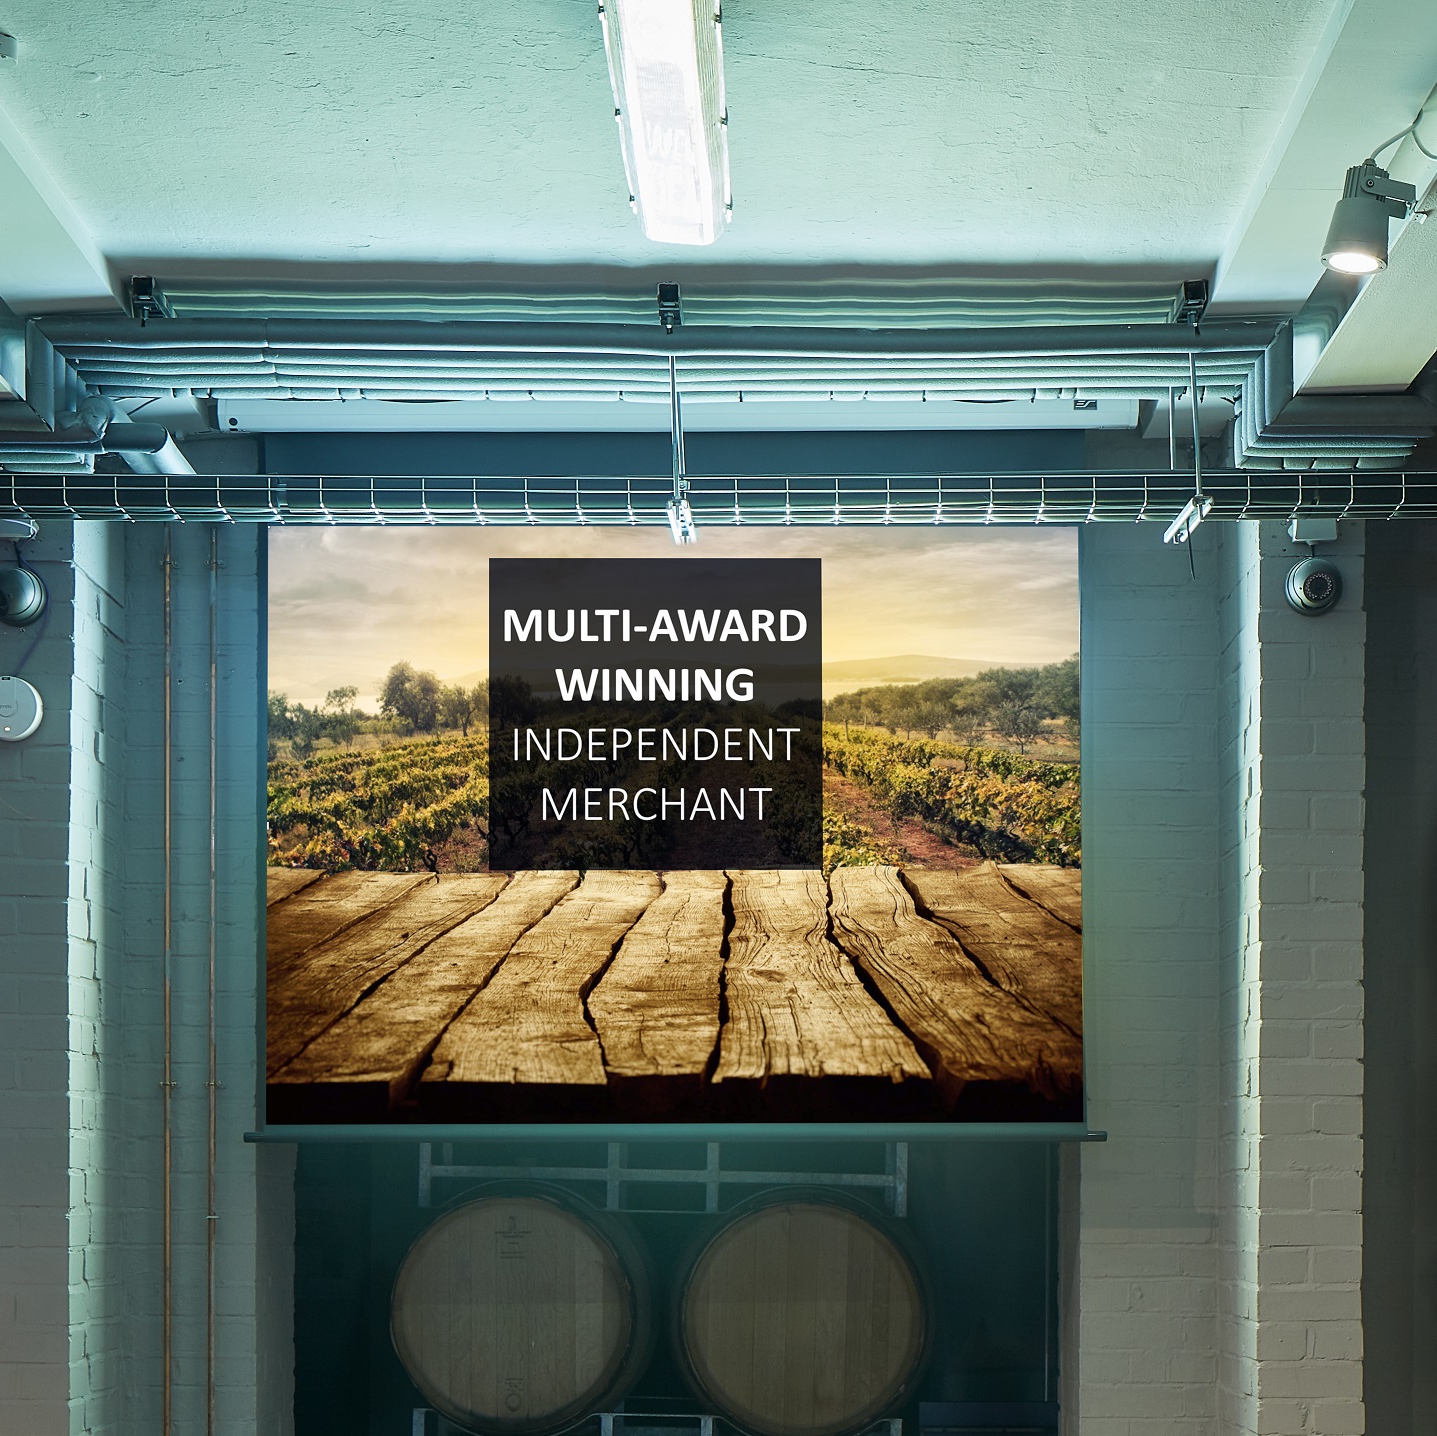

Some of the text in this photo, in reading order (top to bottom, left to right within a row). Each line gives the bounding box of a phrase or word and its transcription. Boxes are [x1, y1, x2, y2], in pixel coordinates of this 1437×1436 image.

[504, 609, 808, 643] MULTI-AWARD
[554, 668, 754, 702] WINNING
[514, 728, 801, 761] INDEPENDENT
[542, 786, 773, 820] MERCHANT
